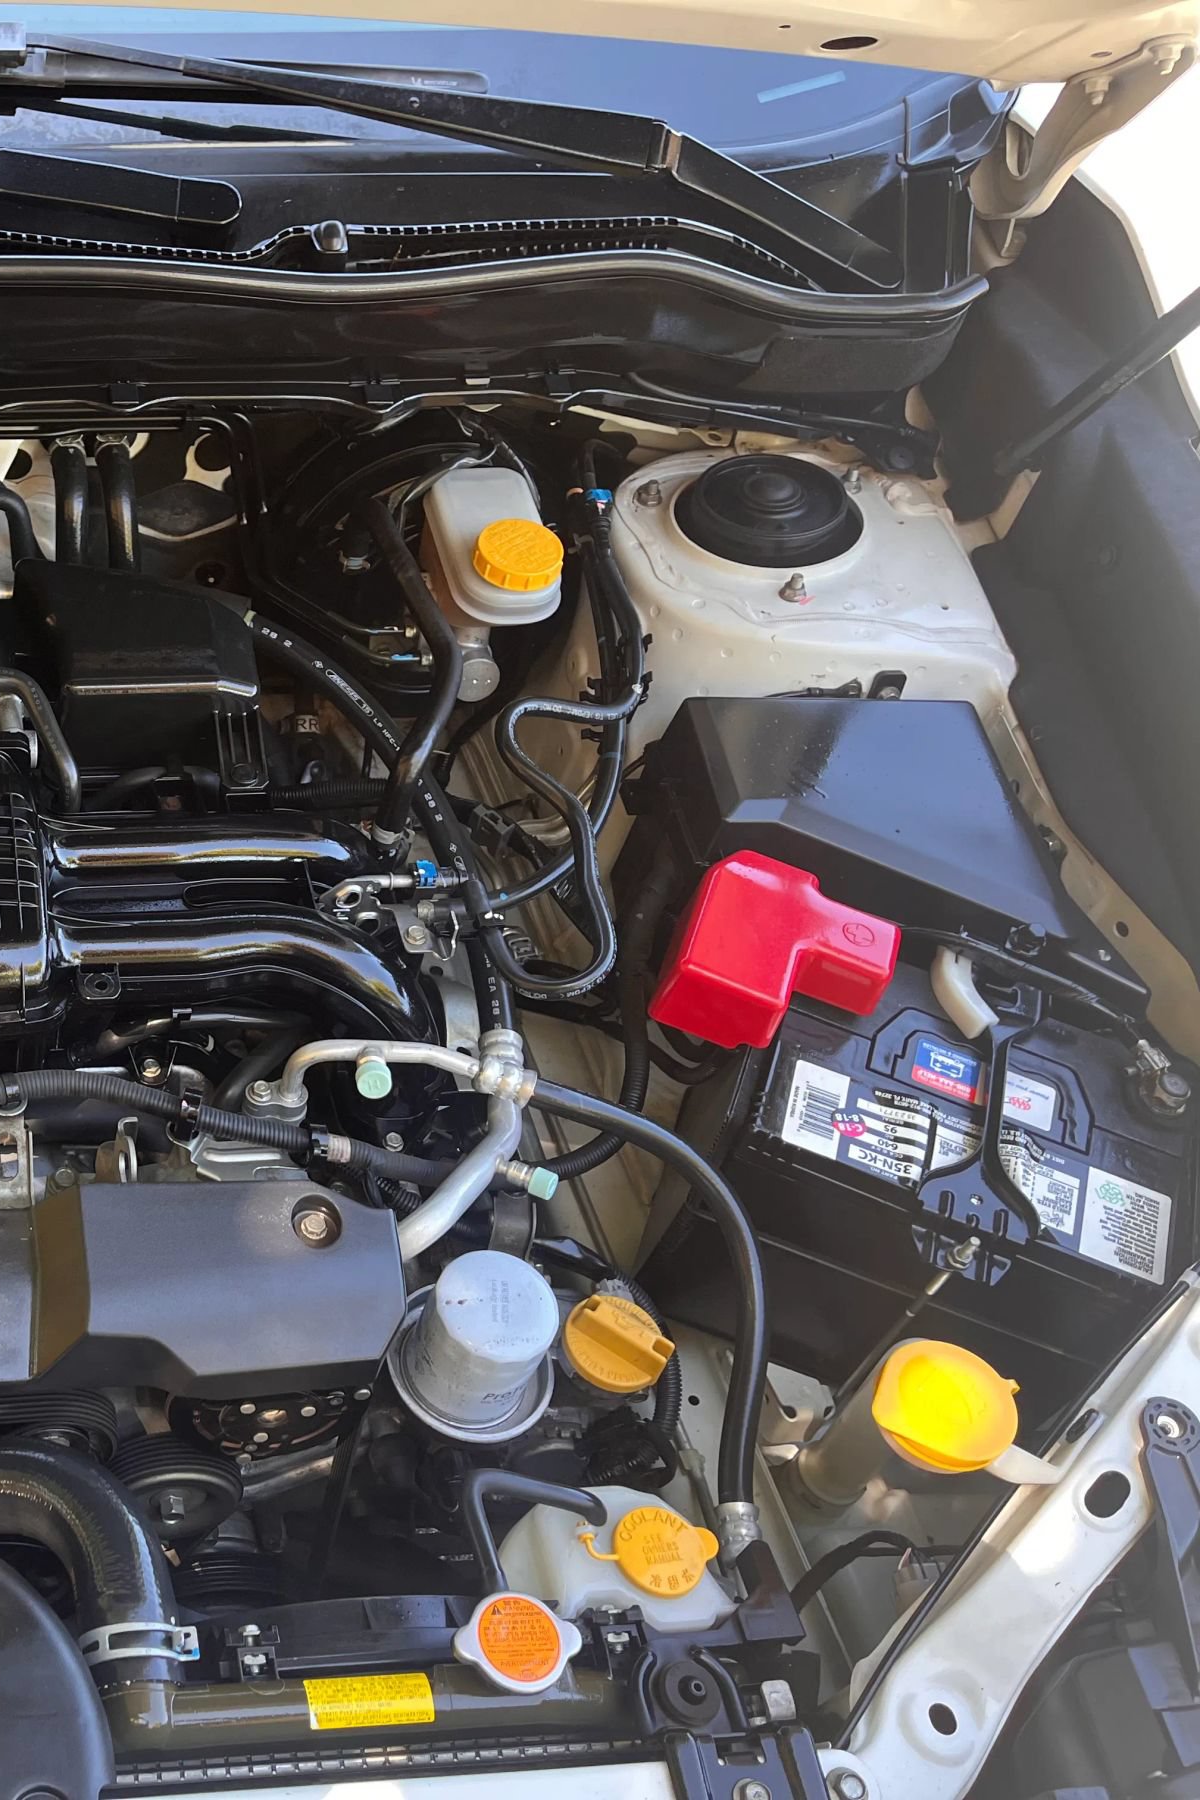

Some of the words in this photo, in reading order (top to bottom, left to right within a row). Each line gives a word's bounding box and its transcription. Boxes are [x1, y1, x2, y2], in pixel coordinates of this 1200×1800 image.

[296, 717, 319, 731] RR
[488, 977, 496, 992] EA
[833, 1108, 860, 1125] 8-18
[836, 1117, 864, 1135] C-18
[882, 1123, 898, 1134] 95
[876, 1137, 898, 1150] 640
[855, 1148, 913, 1175] 35N-KC
[619, 1510, 688, 1542] COOLANT
